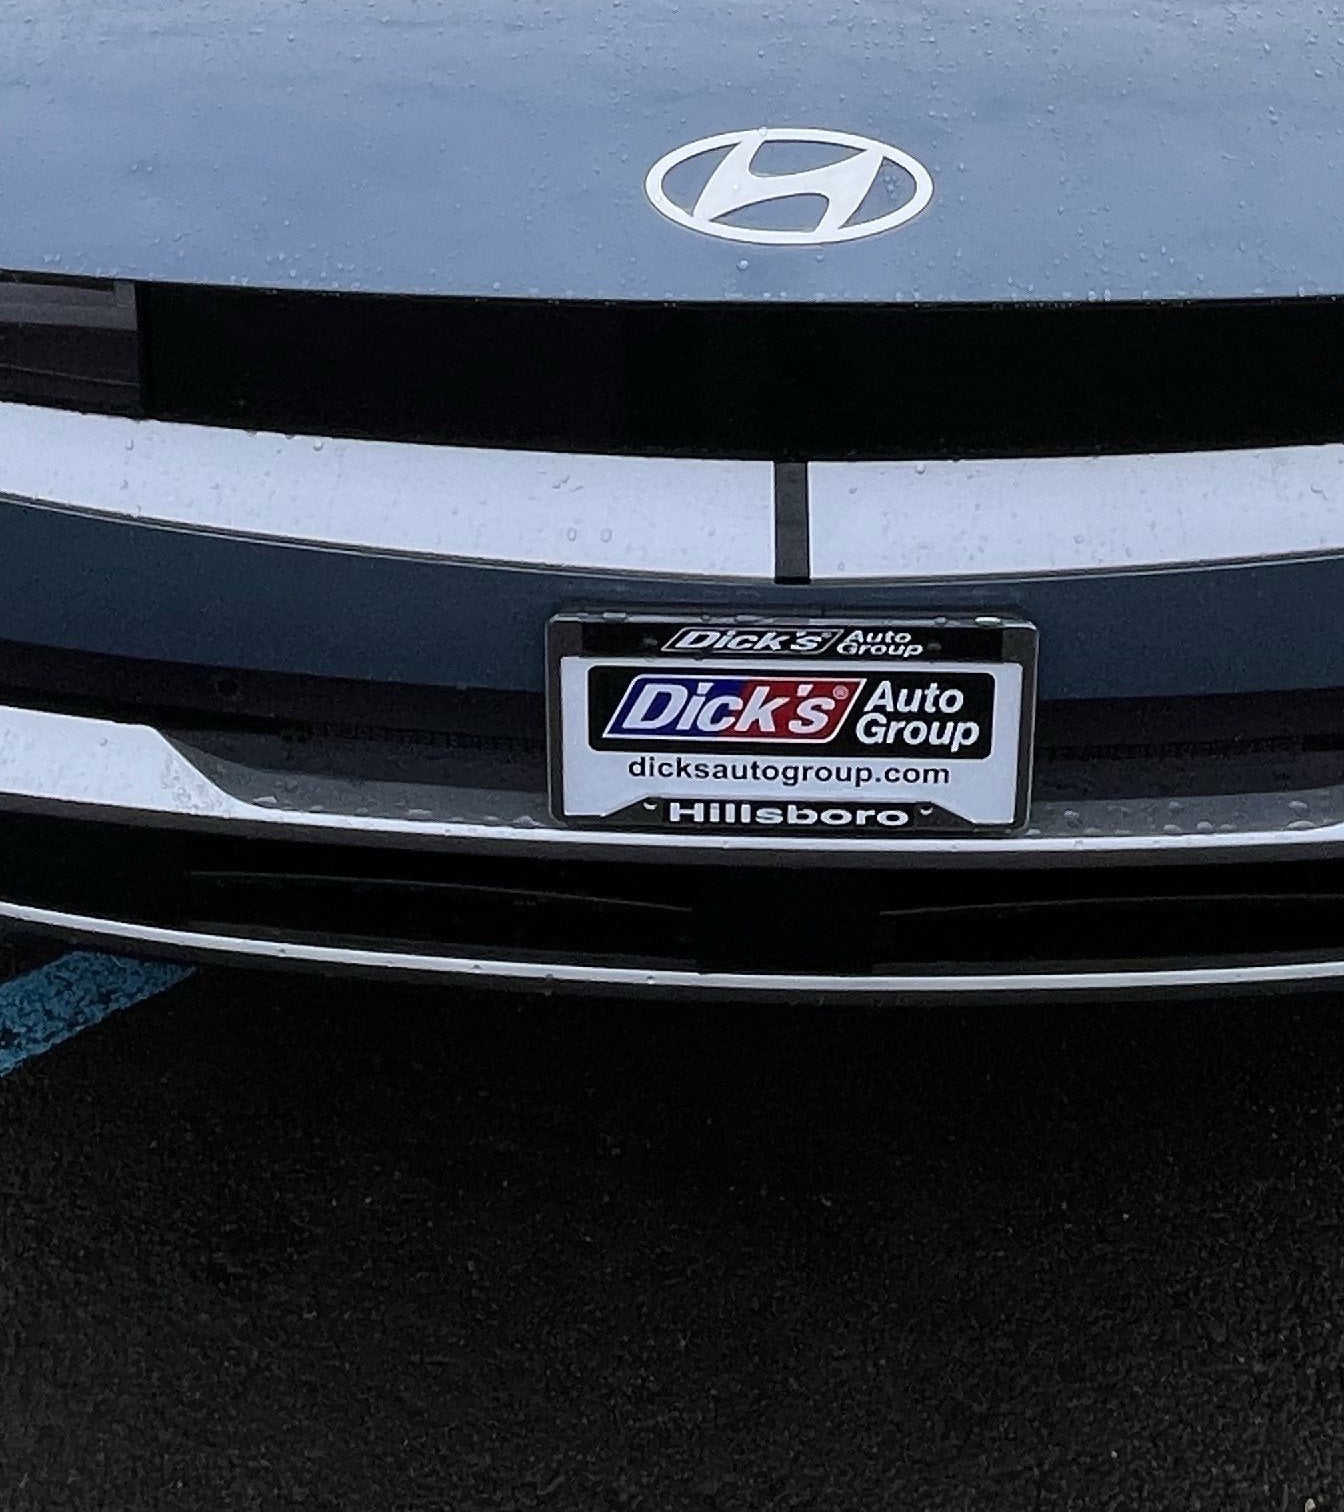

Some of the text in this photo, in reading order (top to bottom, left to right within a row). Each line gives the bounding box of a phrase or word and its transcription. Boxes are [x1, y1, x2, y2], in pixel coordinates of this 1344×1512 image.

[836, 642, 924, 658] Group
[845, 630, 912, 644] Auto
[862, 681, 965, 714] Auto
[855, 713, 980, 752] Group
[628, 756, 951, 787] dicksautogroup.com
[668, 802, 910, 827] Hillsboro
